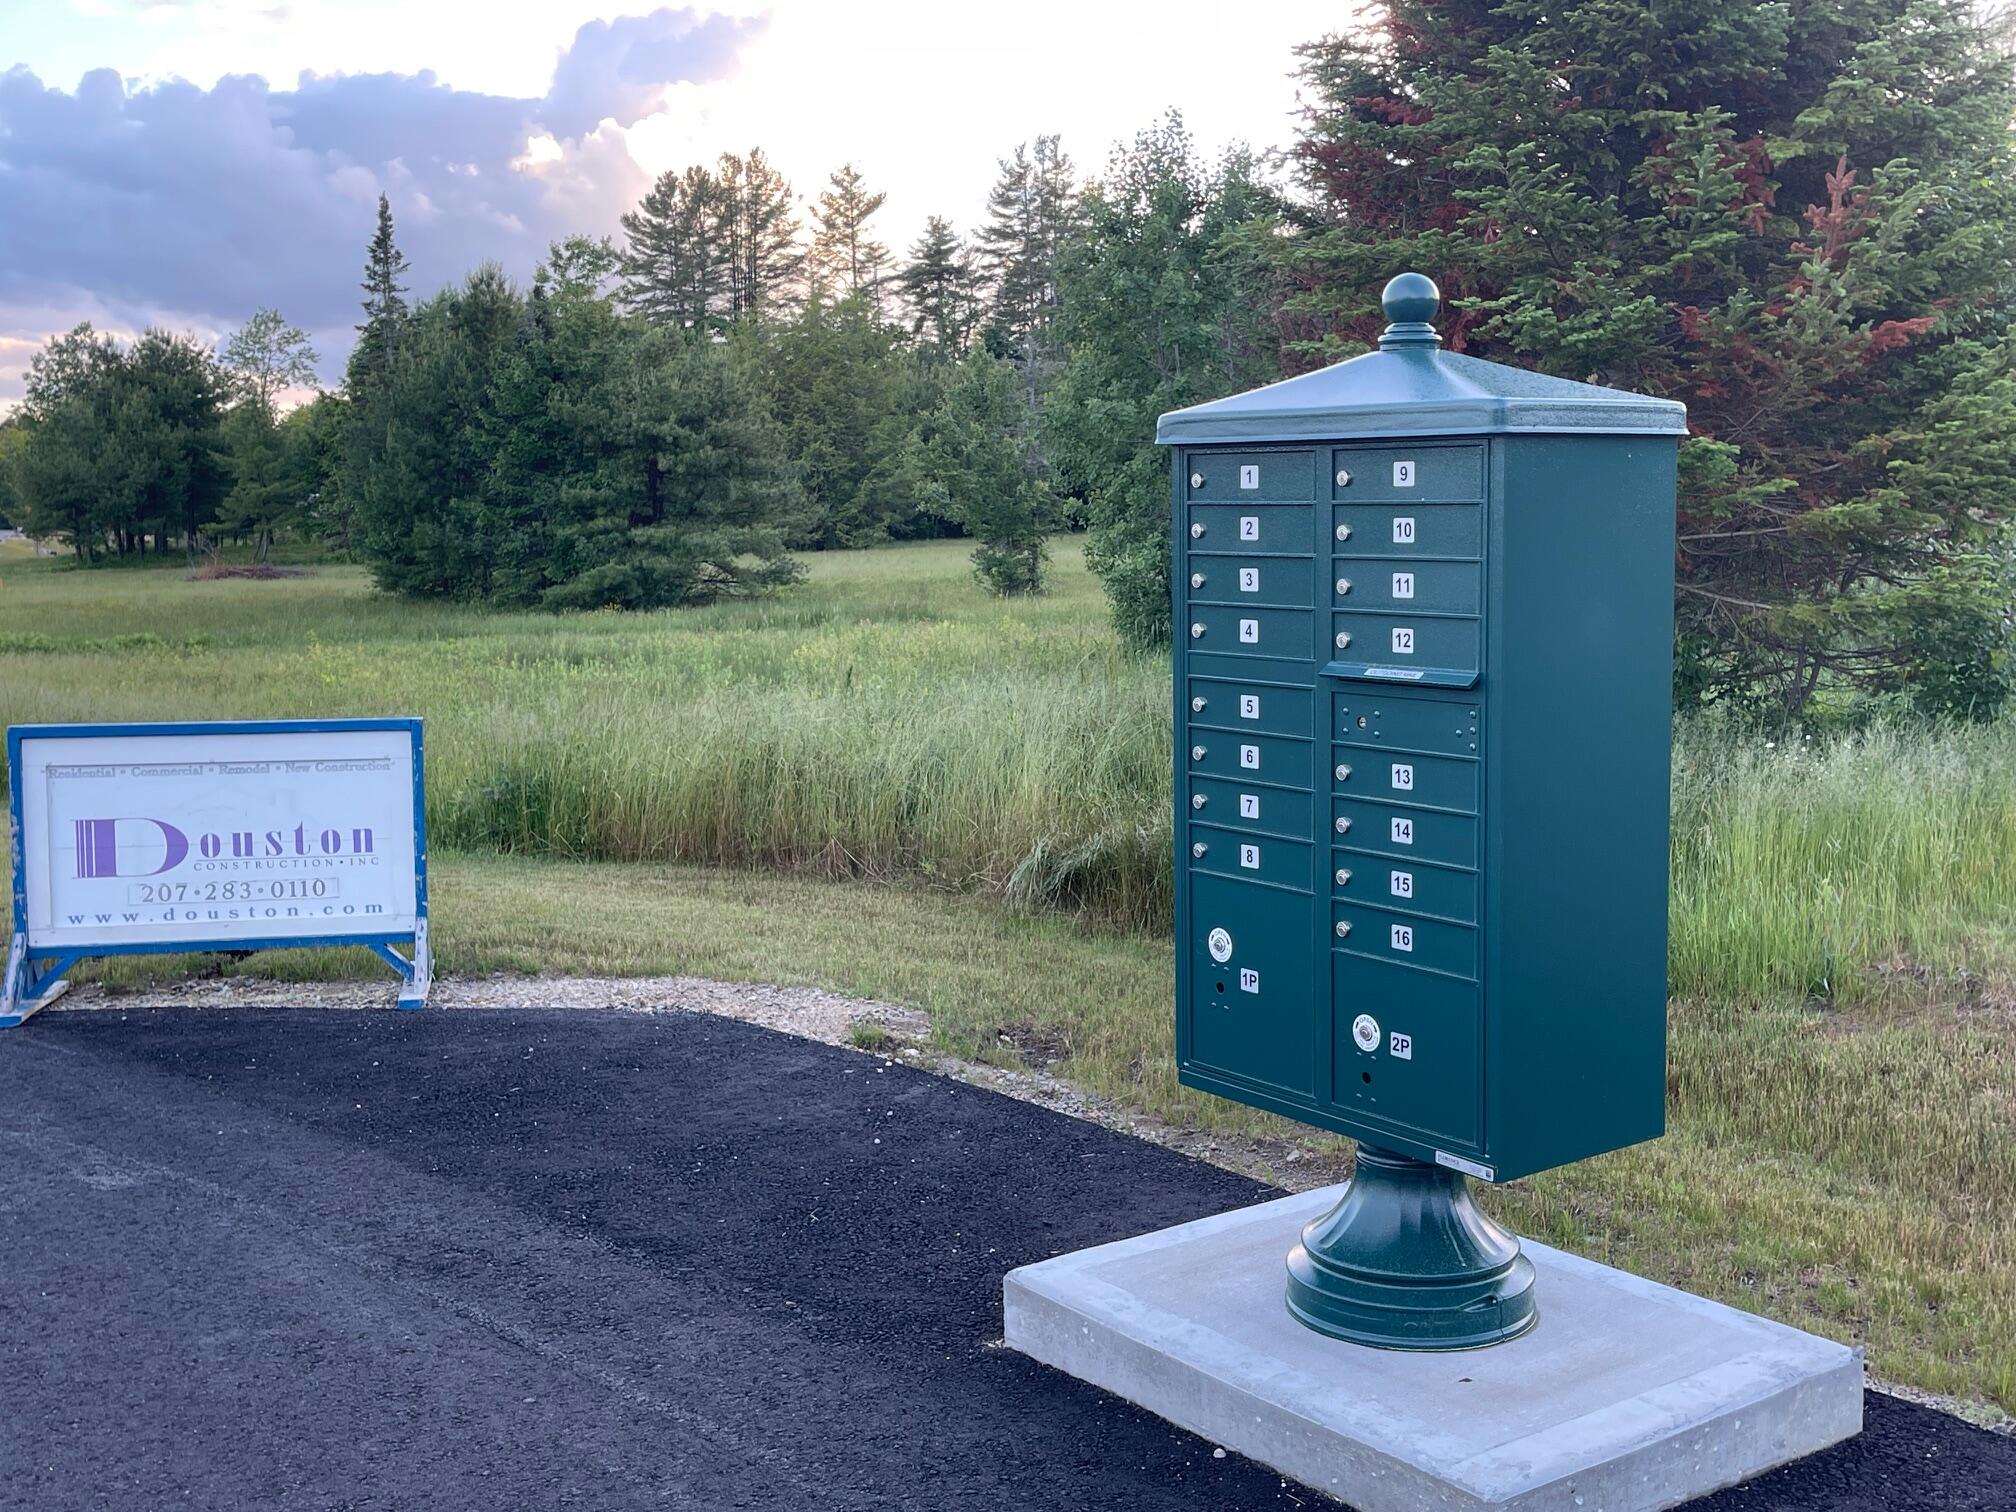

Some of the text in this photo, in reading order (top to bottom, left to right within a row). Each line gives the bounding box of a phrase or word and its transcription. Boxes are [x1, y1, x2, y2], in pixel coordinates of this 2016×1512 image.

[1246, 469, 1252, 484] 1
[1399, 465, 1408, 482] 9
[1246, 521, 1253, 536] 2
[1396, 522, 1412, 538] 10
[1246, 572, 1253, 587] 3
[1395, 577, 1410, 593] 11
[1245, 624, 1253, 638] 4
[1395, 632, 1411, 648] 12
[1246, 699, 1254, 714] 5
[1246, 749, 1254, 764] 6
[48, 760, 391, 779] Residential Commercial Remodel New Construction
[1394, 768, 1411, 785] 13
[1246, 799, 1253, 813] 7
[1394, 822, 1411, 839] 14
[73, 817, 374, 879] Douston
[1246, 849, 1254, 864] 8
[1394, 875, 1410, 893] 15
[68, 902, 384, 925] www.douston.com
[1394, 929, 1410, 946] 16
[1242, 972, 1258, 988] 1P
[1392, 1036, 1410, 1053] 2P
